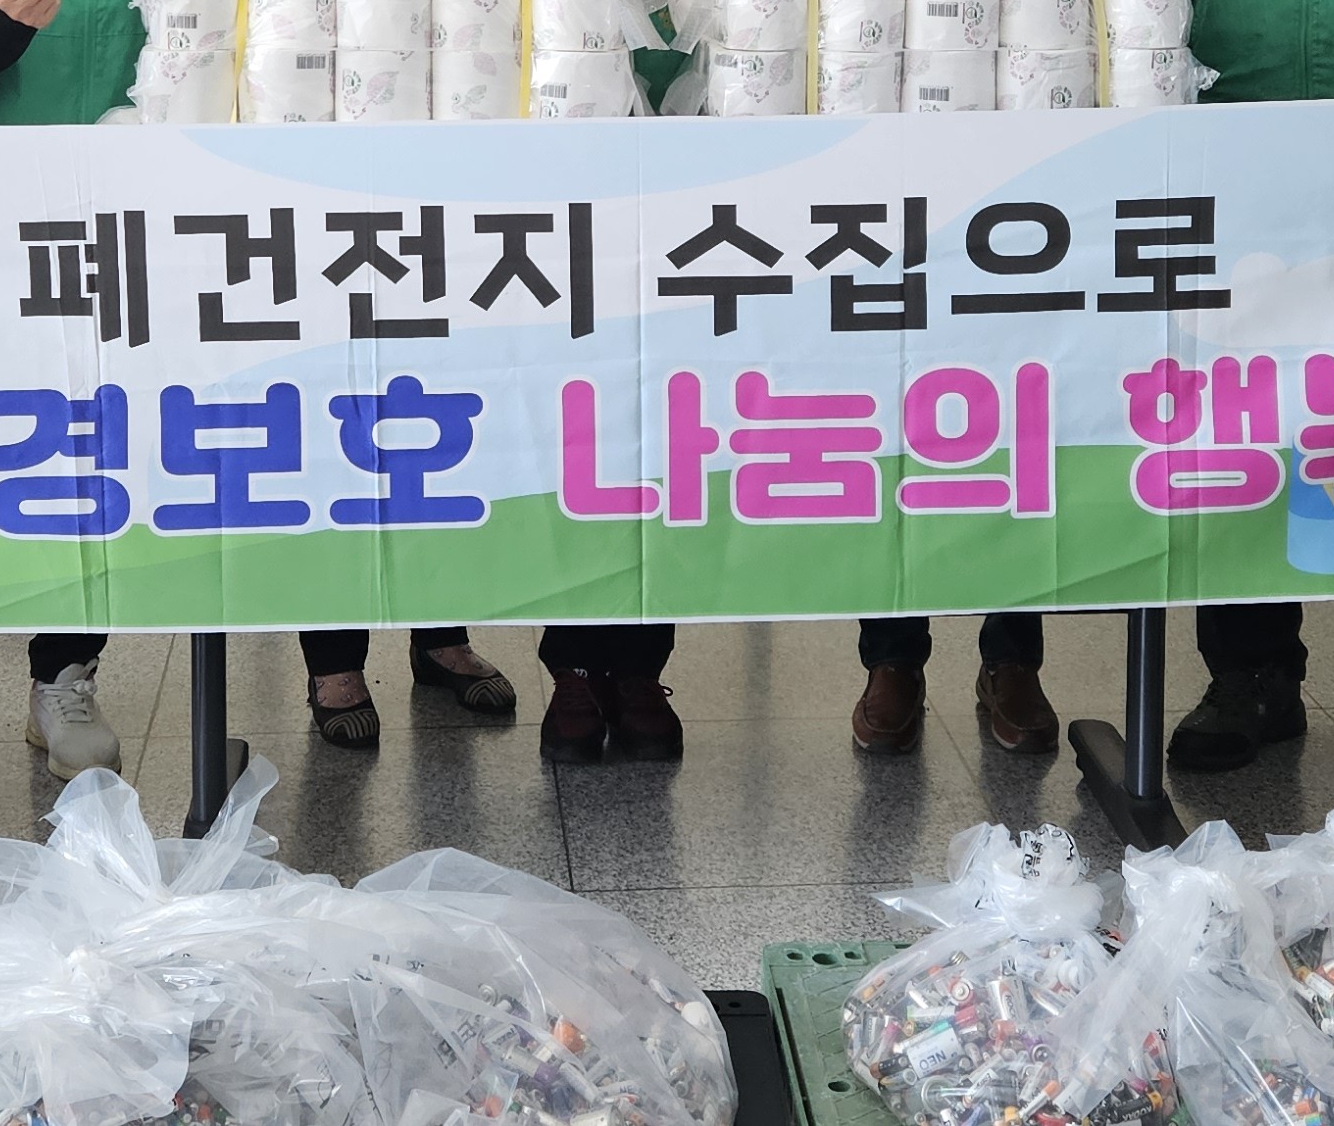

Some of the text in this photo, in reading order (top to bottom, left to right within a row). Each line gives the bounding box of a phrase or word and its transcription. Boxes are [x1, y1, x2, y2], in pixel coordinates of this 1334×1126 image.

[18, 195, 1232, 349] 폐건전지 수집으로
[559, 360, 1058, 528] 나눔의
[918, 1048, 947, 1070] NEO
